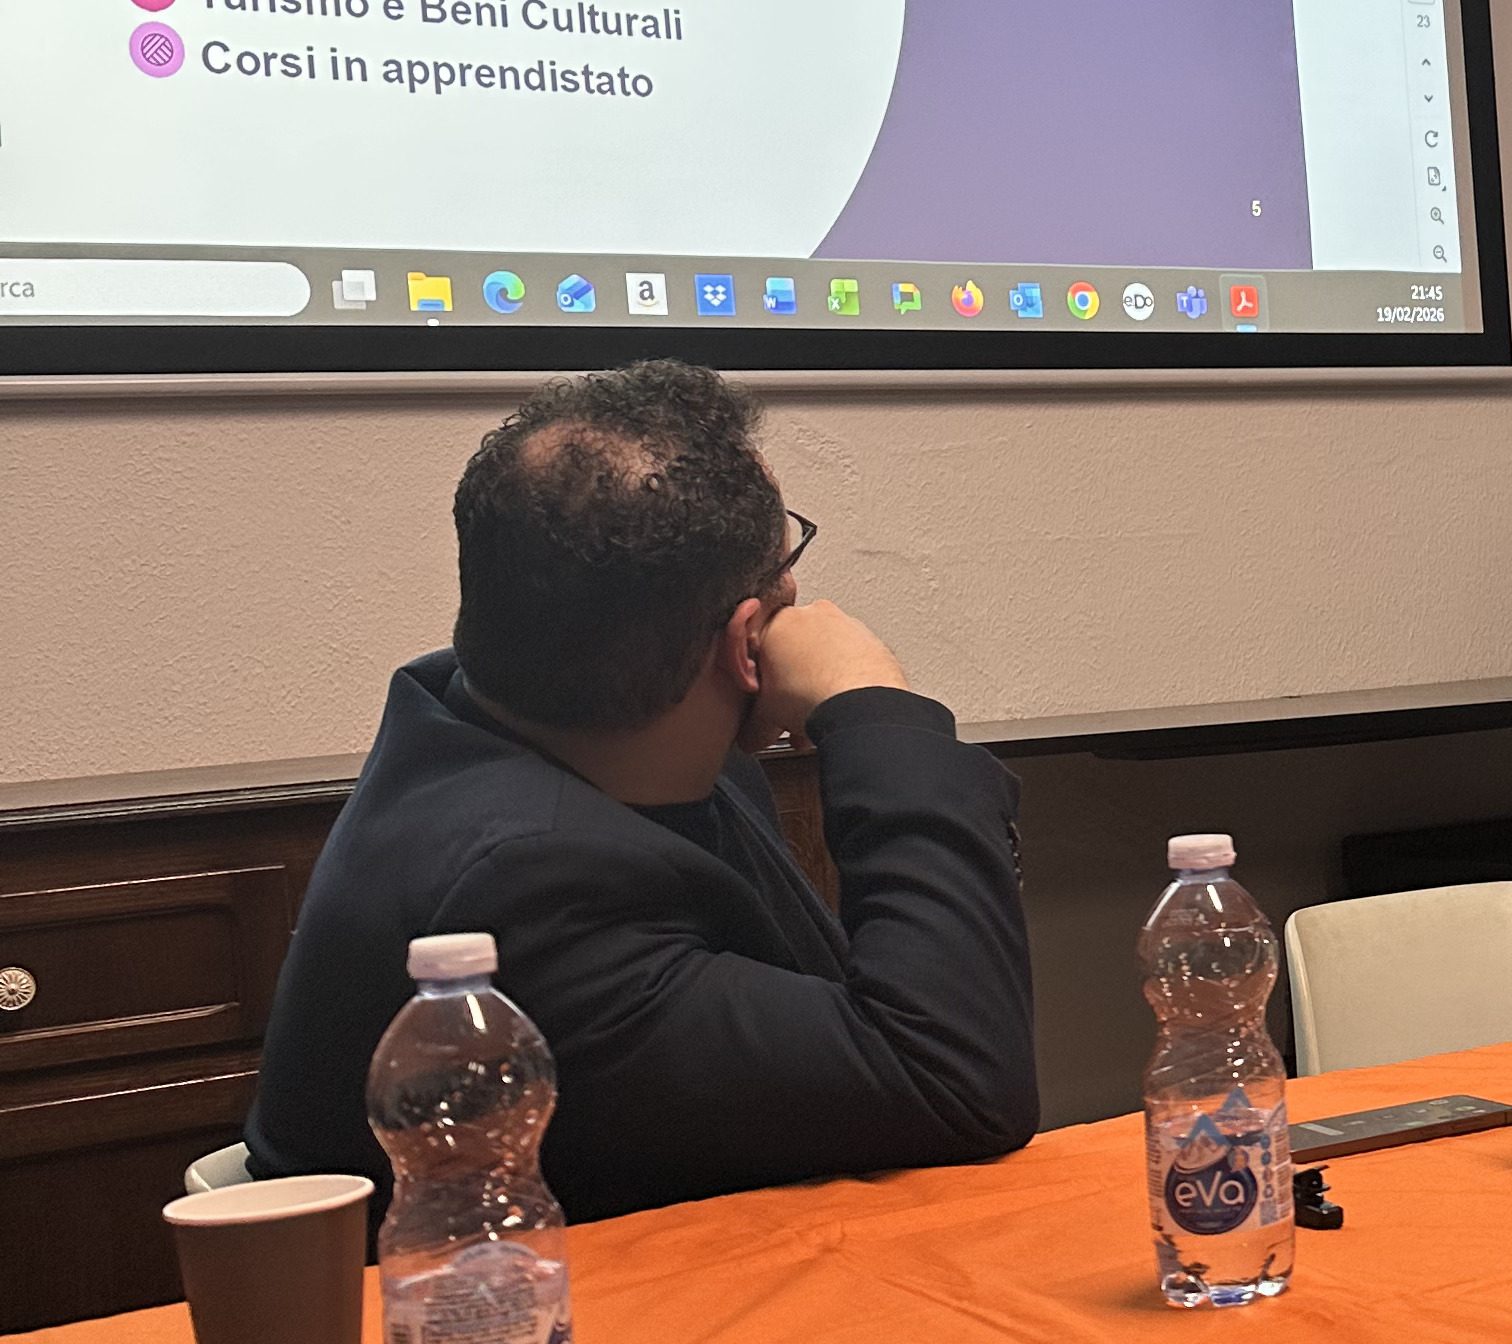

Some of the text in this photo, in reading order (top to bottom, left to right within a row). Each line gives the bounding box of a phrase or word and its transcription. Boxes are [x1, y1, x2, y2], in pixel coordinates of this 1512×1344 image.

[1416, 14, 1431, 29] 23
[201, 40, 655, 98] Corsi in apprendistato
[1251, 199, 1262, 218] 5
[1410, 284, 1443, 301] 21:45
[1376, 306, 1445, 324] 19/02/2026
